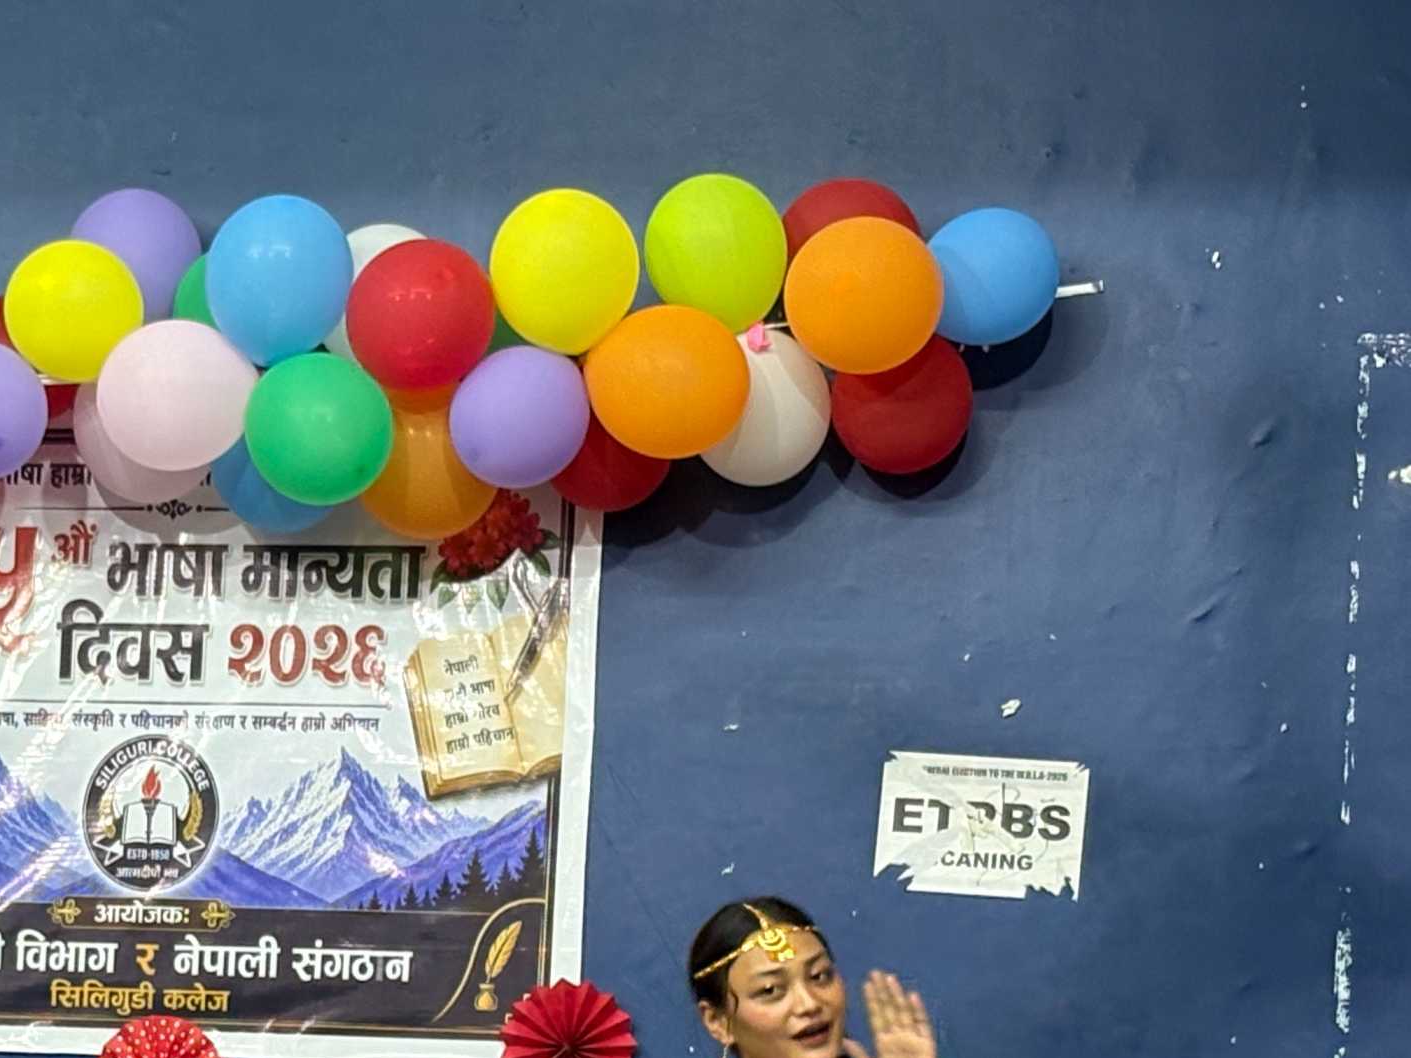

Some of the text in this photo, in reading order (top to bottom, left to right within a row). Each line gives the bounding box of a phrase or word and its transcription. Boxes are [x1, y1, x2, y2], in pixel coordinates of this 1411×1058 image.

[107, 541, 229, 597] भाषा
[241, 545, 426, 599] मान्यता
[56, 598, 386, 686] दिवस २०२६
[95, 740, 210, 792] SILIGURI COLLEGE
[16, 928, 119, 974] विभाग
[135, 942, 160, 975] र
[173, 934, 281, 979] नेपाली
[162, 983, 231, 1012] कलेज
